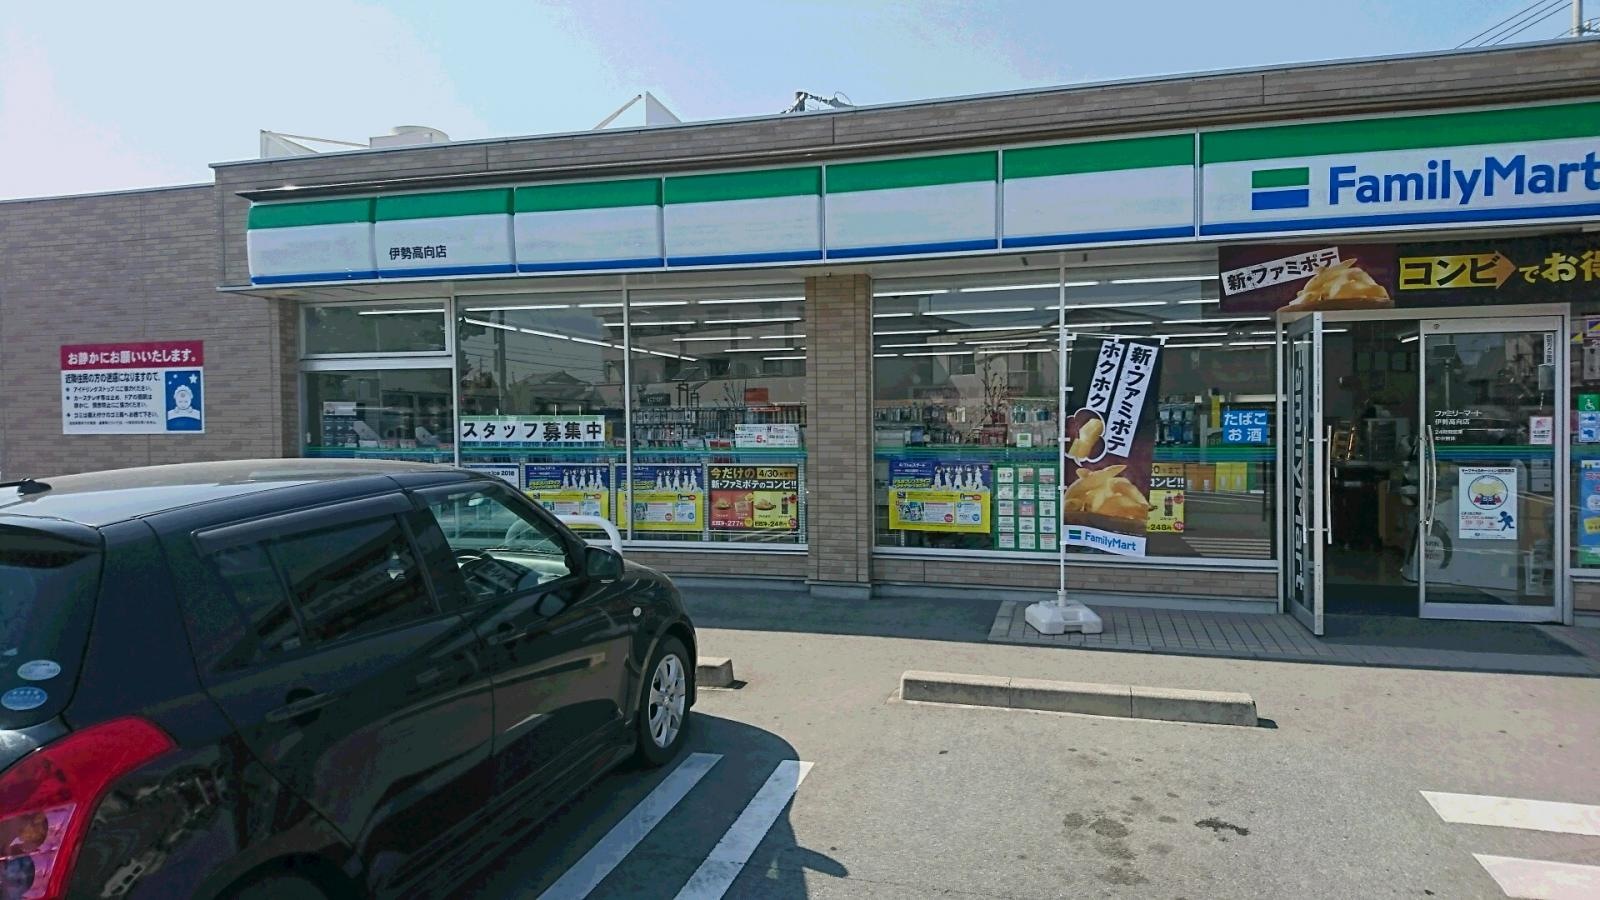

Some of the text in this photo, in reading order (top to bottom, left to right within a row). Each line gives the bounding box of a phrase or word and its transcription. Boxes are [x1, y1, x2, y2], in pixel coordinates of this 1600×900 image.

[1329, 152, 1600, 205] FamilyMart
[389, 245, 447, 260] 伊勢高向店
[1404, 256, 1499, 286] コンビ
[1090, 343, 1121, 409] ホクホク
[1224, 412, 1267, 425] たばこ
[463, 421, 602, 441] スタッフ募集中
[1228, 428, 1262, 441] お酒
[711, 467, 756, 479] 今だけの
[1084, 532, 1137, 551] FamilyMart
